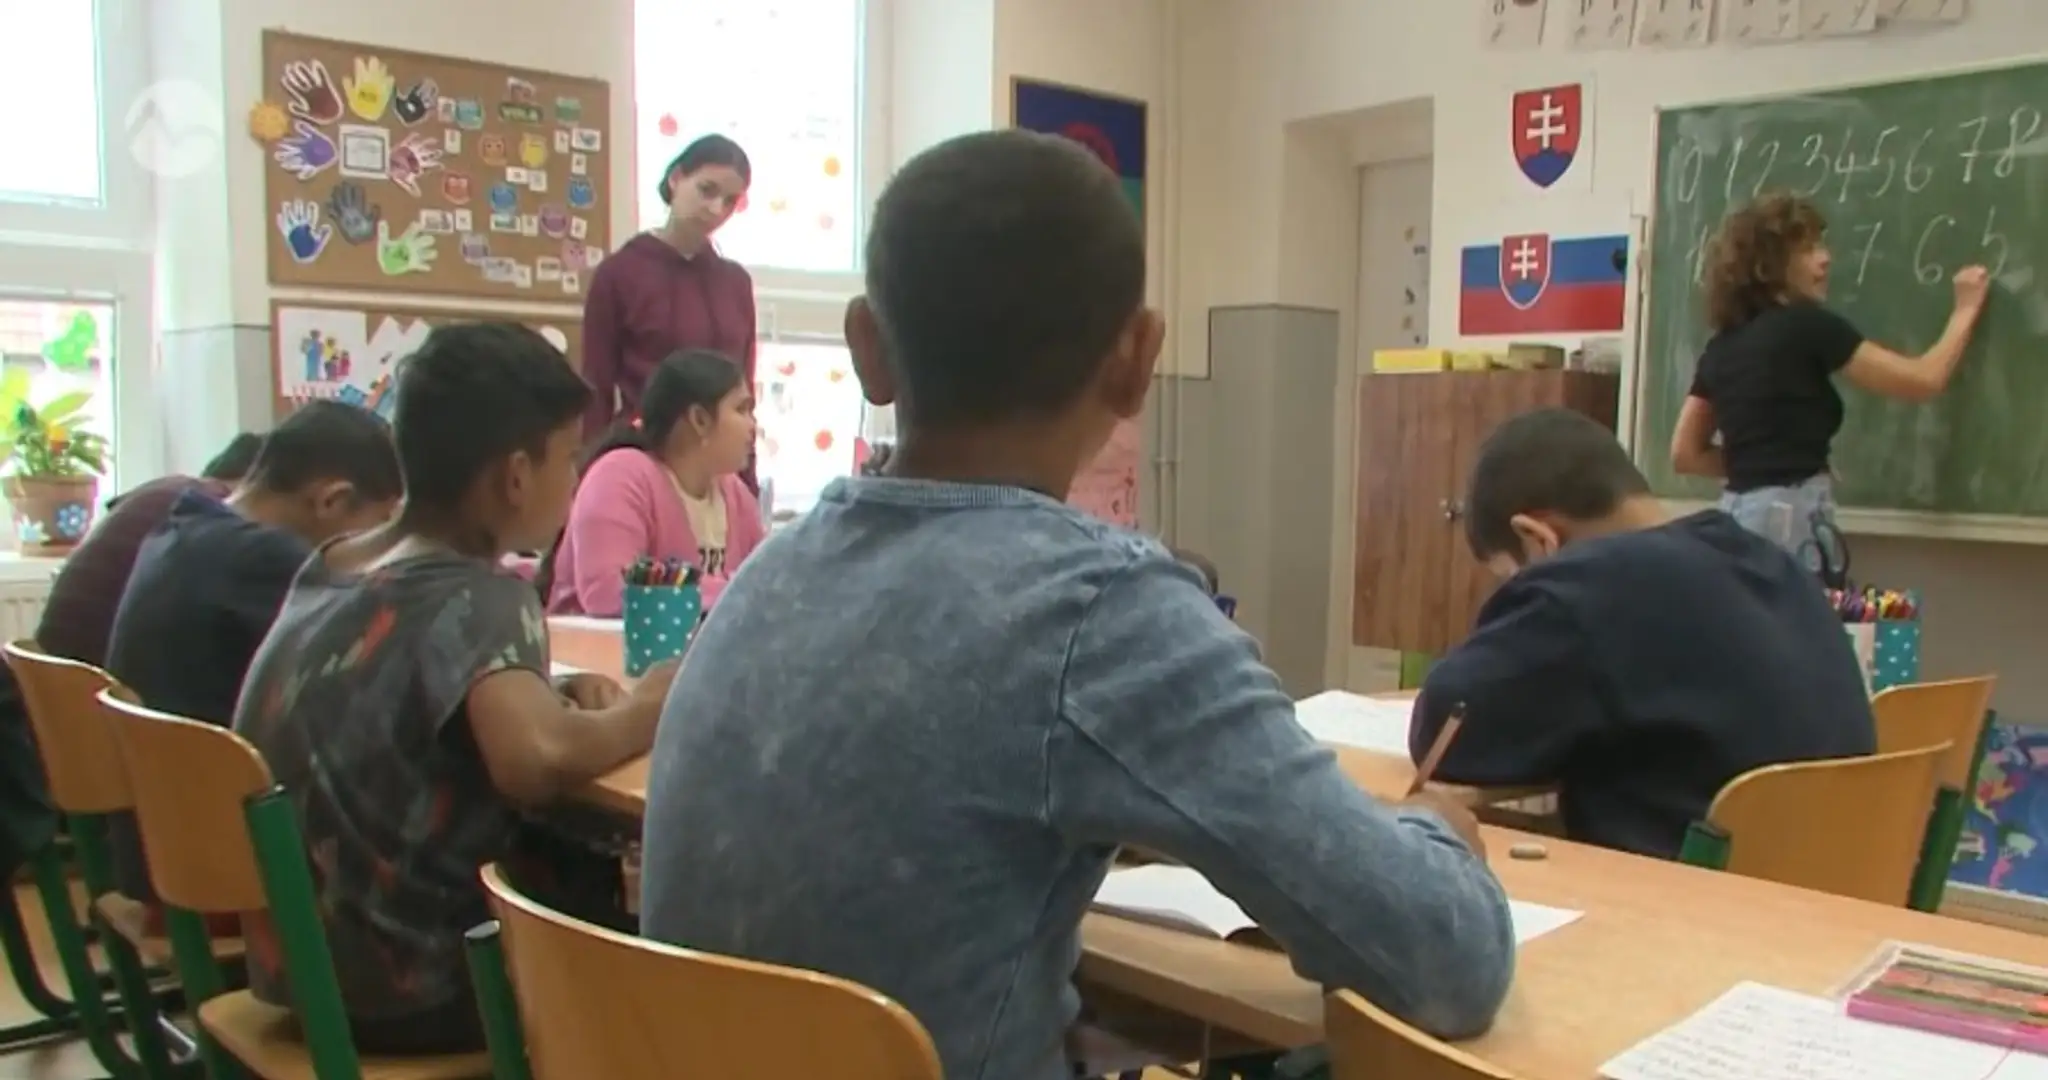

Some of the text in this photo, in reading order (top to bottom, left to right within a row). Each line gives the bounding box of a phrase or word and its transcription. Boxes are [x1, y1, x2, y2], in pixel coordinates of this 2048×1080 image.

[1677, 104, 2041, 203] 0 1 2 3 4 5 6 7 8
[1852, 220, 1884, 286] 7
[1913, 212, 1957, 286] 6
